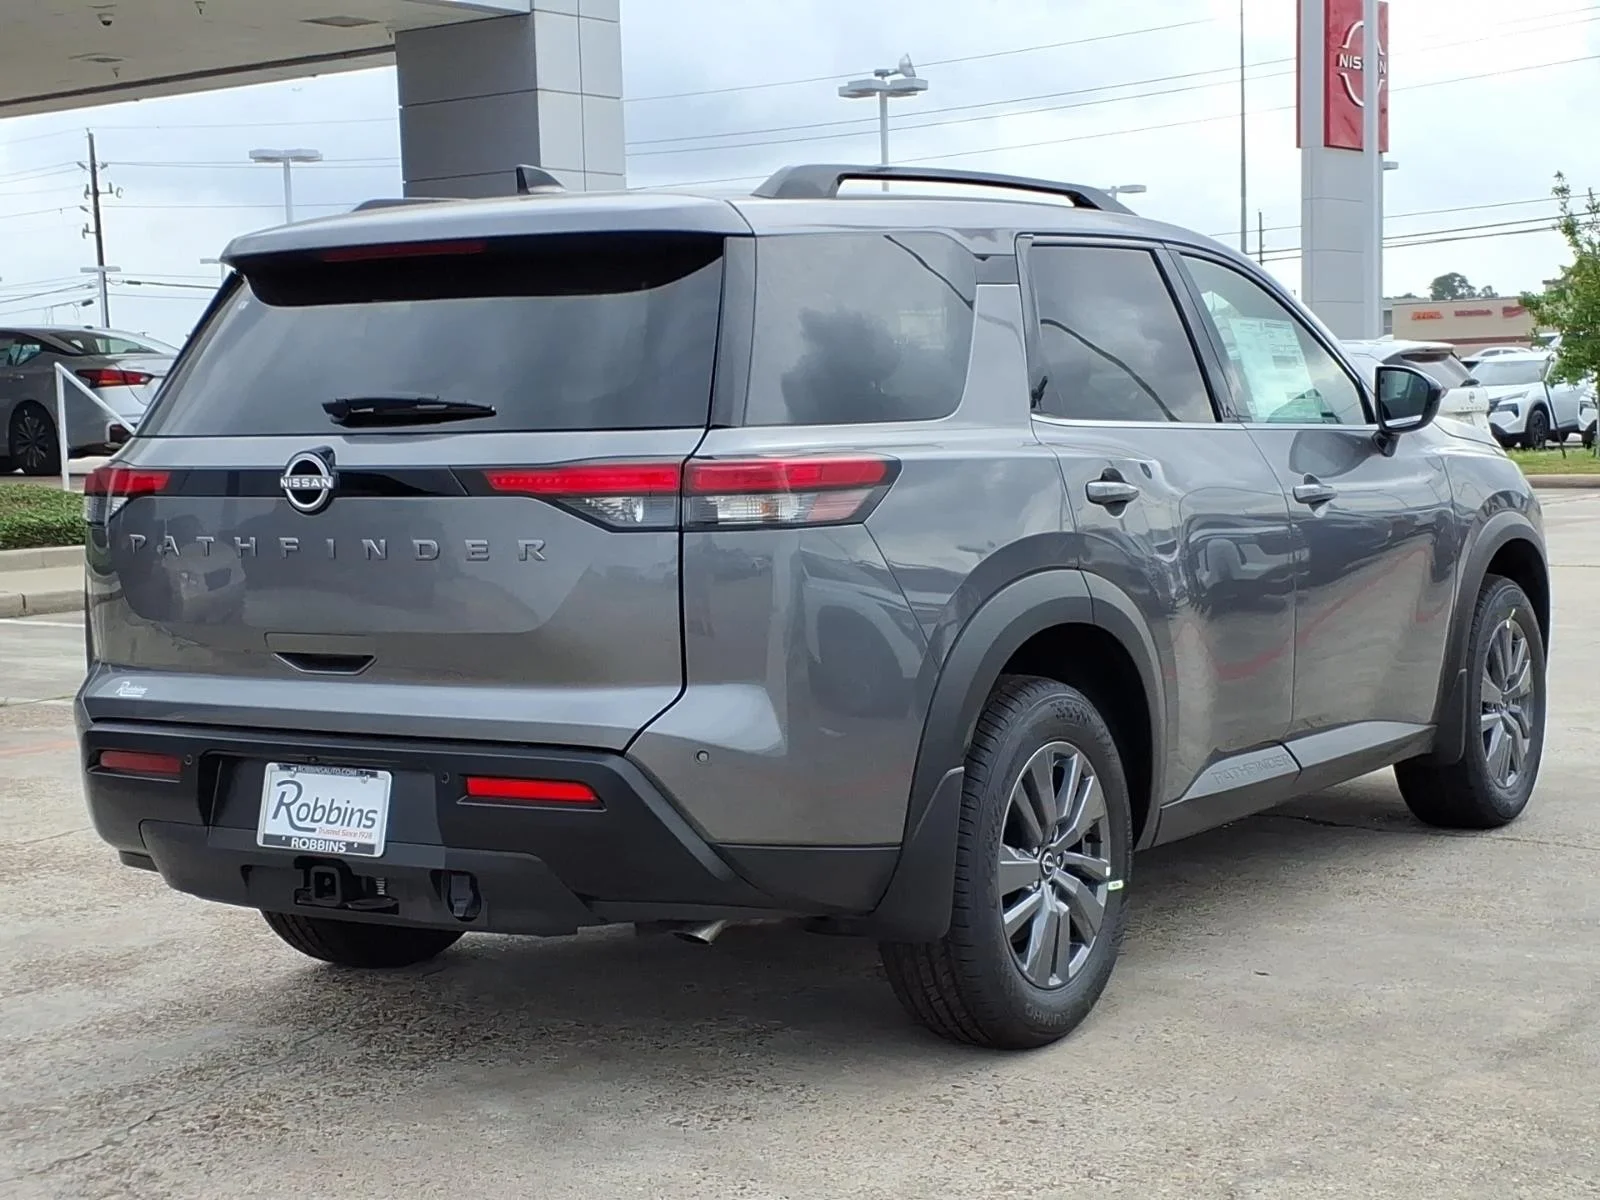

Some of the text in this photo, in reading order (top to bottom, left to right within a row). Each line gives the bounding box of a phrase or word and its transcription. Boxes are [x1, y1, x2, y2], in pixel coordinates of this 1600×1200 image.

[1339, 53, 1386, 74] NISN
[280, 476, 333, 490] NISSAN
[129, 533, 547, 562] PATHFINDER
[272, 780, 377, 832] Robbins
[291, 838, 347, 853] ROBBINS
